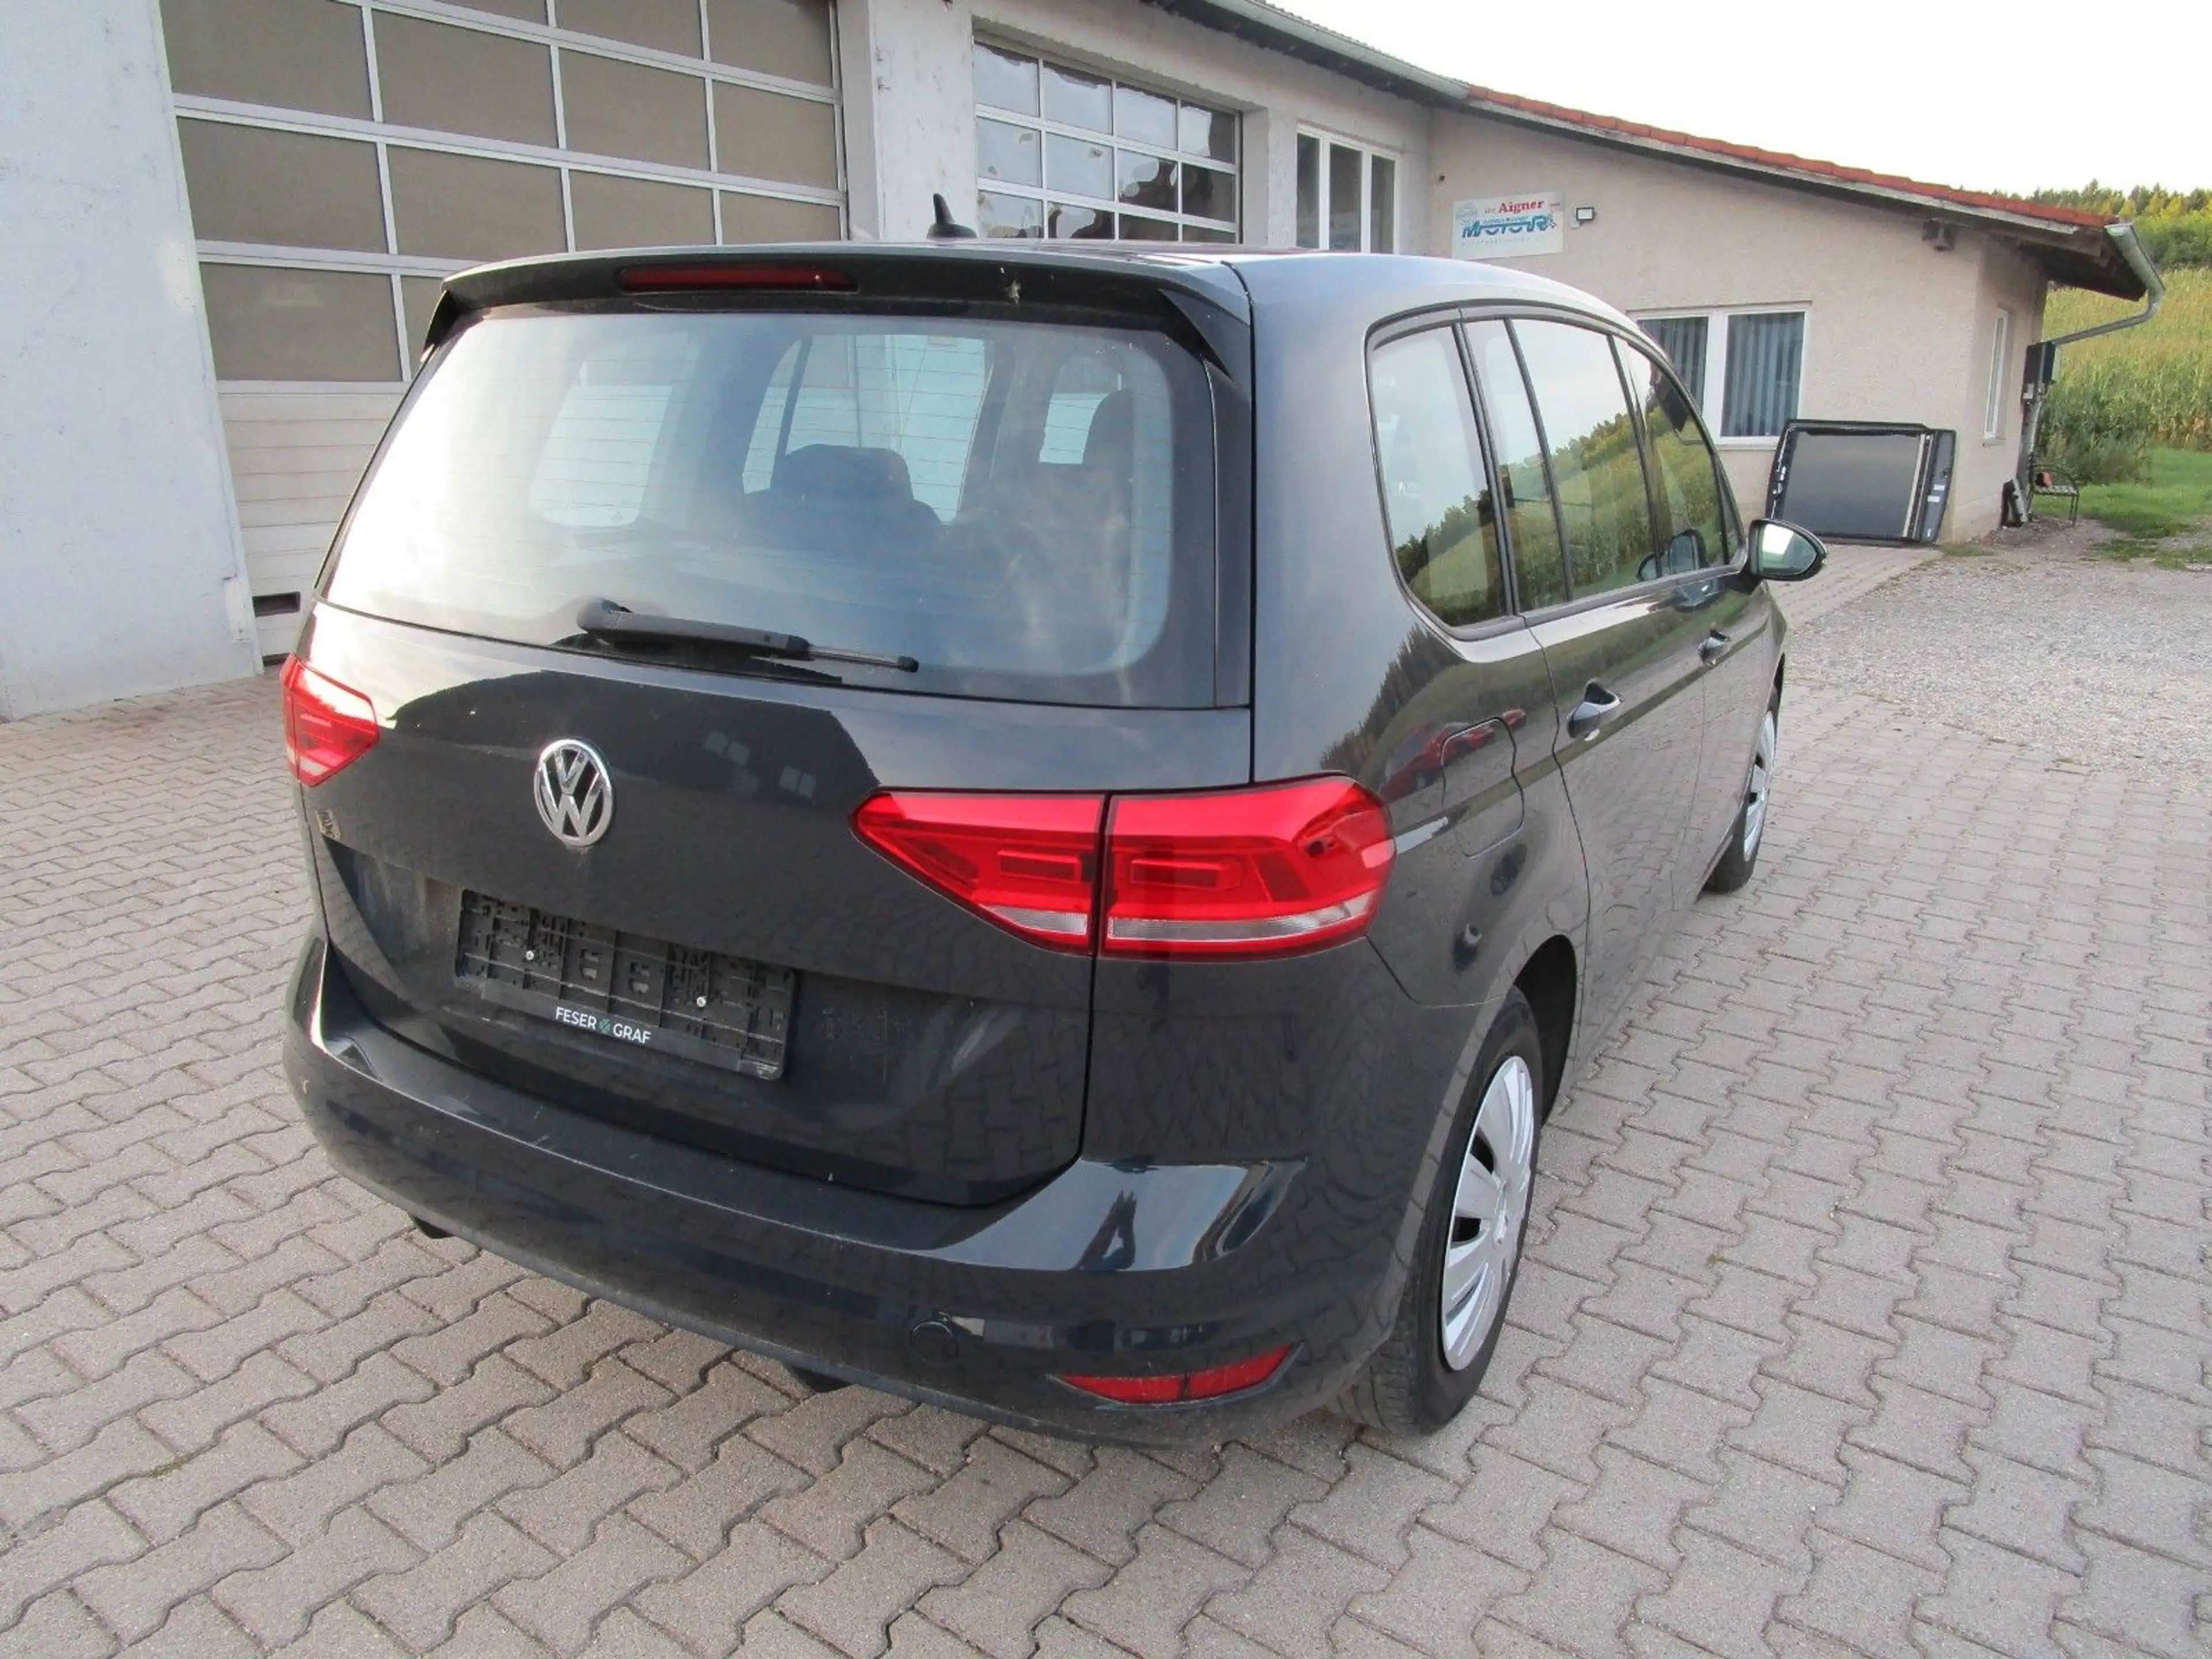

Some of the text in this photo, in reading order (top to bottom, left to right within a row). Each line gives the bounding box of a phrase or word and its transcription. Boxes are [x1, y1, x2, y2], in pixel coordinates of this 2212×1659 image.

[1498, 200, 1545, 214] Aigner
[534, 739, 612, 846] VW
[555, 1006, 652, 1044] FESER GRAF
